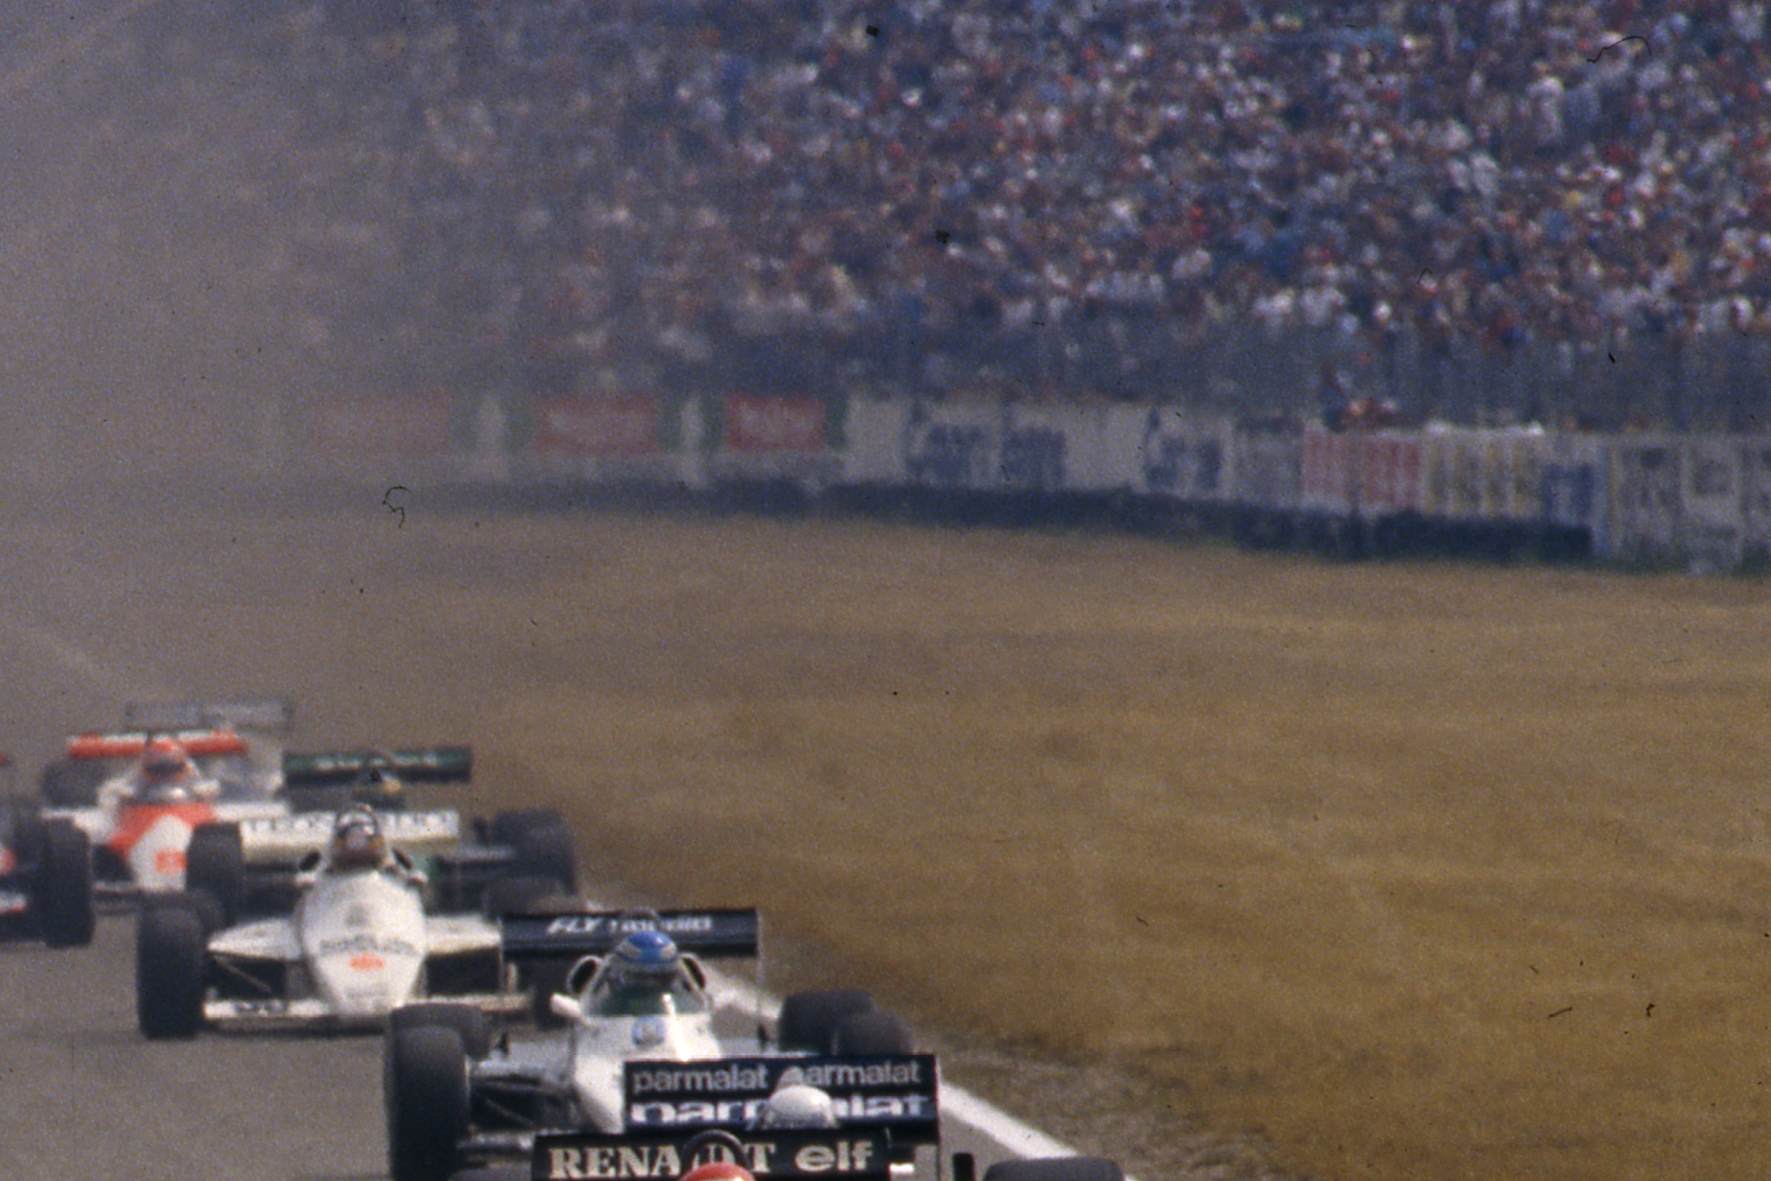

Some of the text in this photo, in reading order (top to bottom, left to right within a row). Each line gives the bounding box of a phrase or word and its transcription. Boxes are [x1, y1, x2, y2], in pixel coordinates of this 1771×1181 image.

[633, 1060, 921, 1094] parmalat armalat
[630, 1095, 928, 1122] parlat
[794, 1140, 874, 1173] elf
